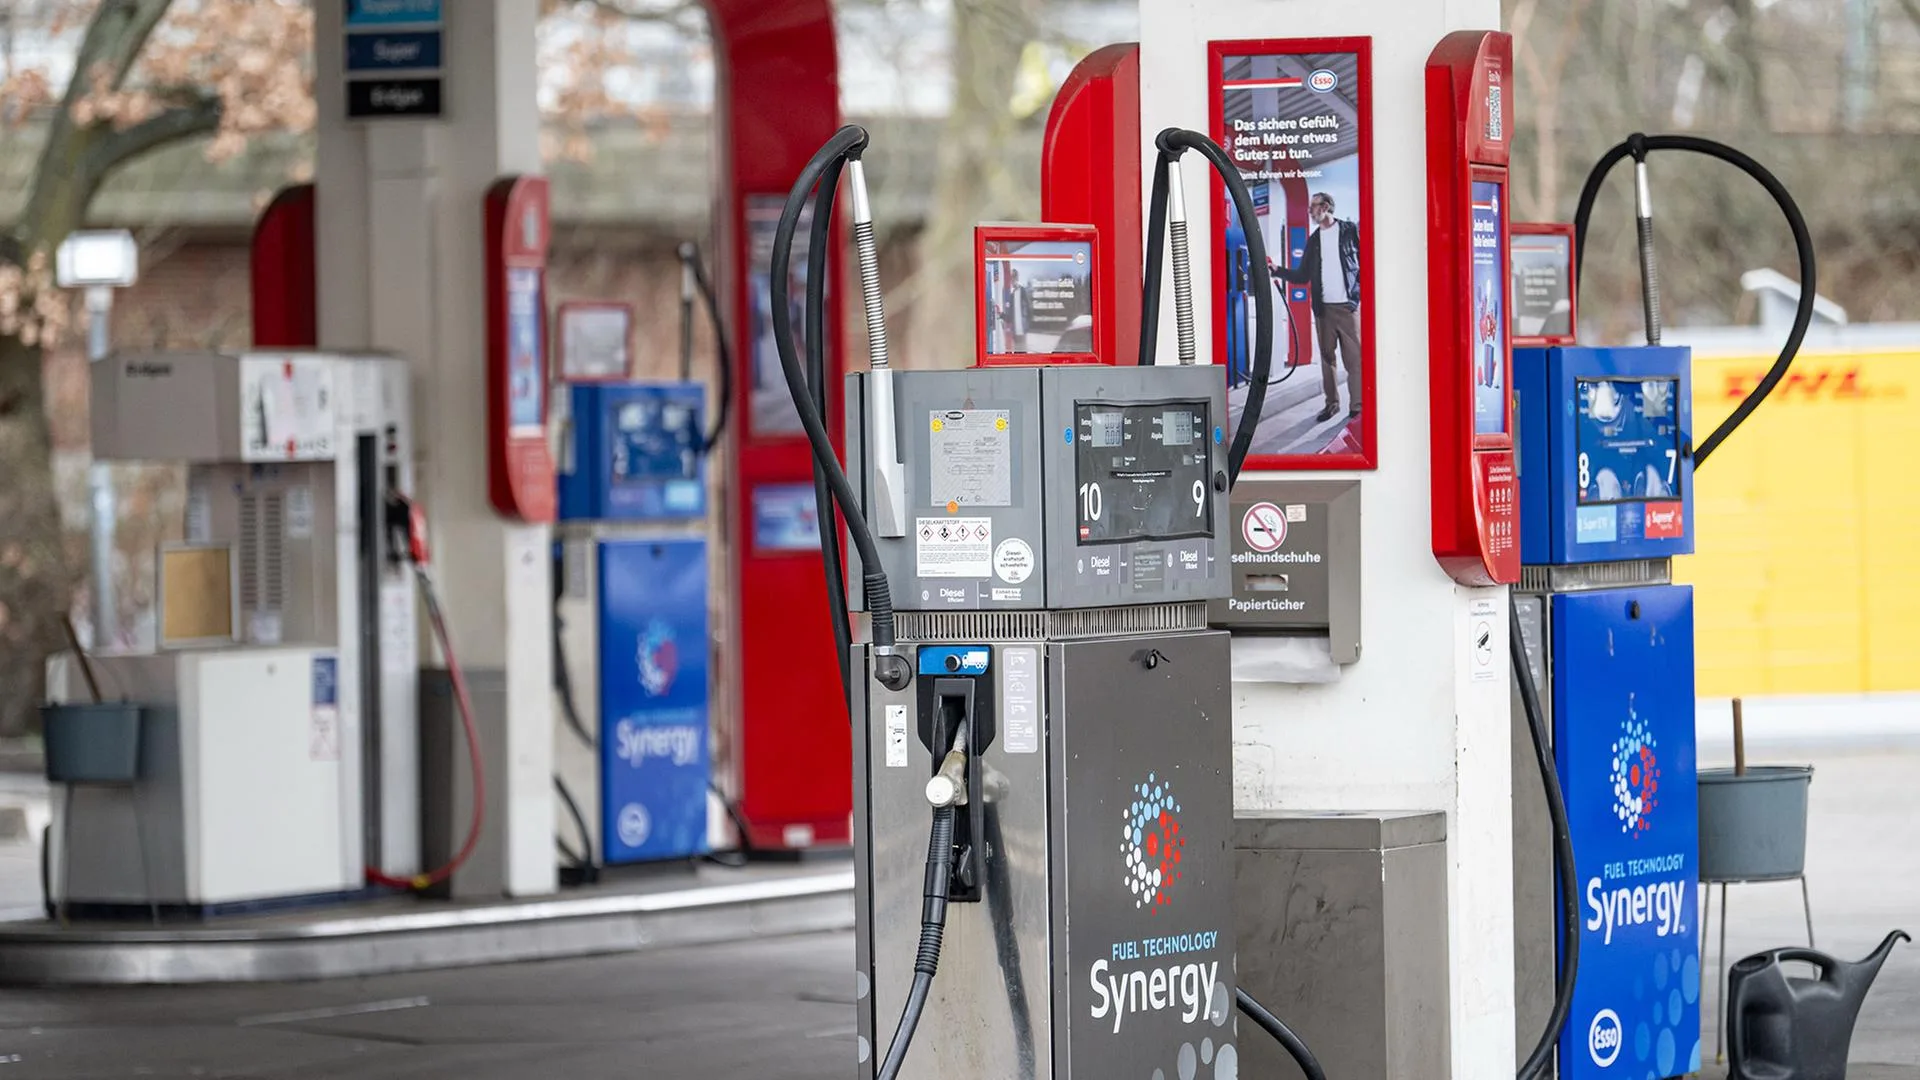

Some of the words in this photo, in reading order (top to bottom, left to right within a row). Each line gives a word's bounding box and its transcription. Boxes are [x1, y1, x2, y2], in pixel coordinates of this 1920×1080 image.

[1314, 77, 1333, 85] Esso
[1234, 119, 1255, 131] Das
[1257, 117, 1297, 130] sichere
[1299, 115, 1339, 130] Gefühl,
[1234, 134, 1260, 146] dem
[1263, 133, 1300, 145] Motor
[1302, 132, 1337, 144] etwas
[1234, 150, 1269, 161] Gutes
[1272, 150, 1286, 160] zu
[1288, 148, 1312, 159] tun.
[1240, 171, 1257, 180] amit
[1578, 452, 1590, 488] 8
[1665, 450, 1677, 484] 7
[1080, 482, 1102, 521] 10
[1192, 480, 1205, 517] 9
[1091, 556, 1110, 568] Diesel
[1180, 550, 1198, 562] Diesel
[1231, 551, 1321, 563] selhandschuhe
[940, 588, 965, 597] Diesel
[1228, 599, 1305, 612] Papiertücher
[616, 719, 698, 768] Synergy
[1604, 861, 1626, 880] FUEL
[1628, 853, 1684, 876] TECHNOLOGY
[1586, 877, 1685, 945] Synergy
[1112, 941, 1140, 961] FUEL
[1142, 930, 1217, 957] TECHNOLOGY
[1090, 959, 1218, 1034] Synergy
[1594, 1025, 1616, 1049] Esso
